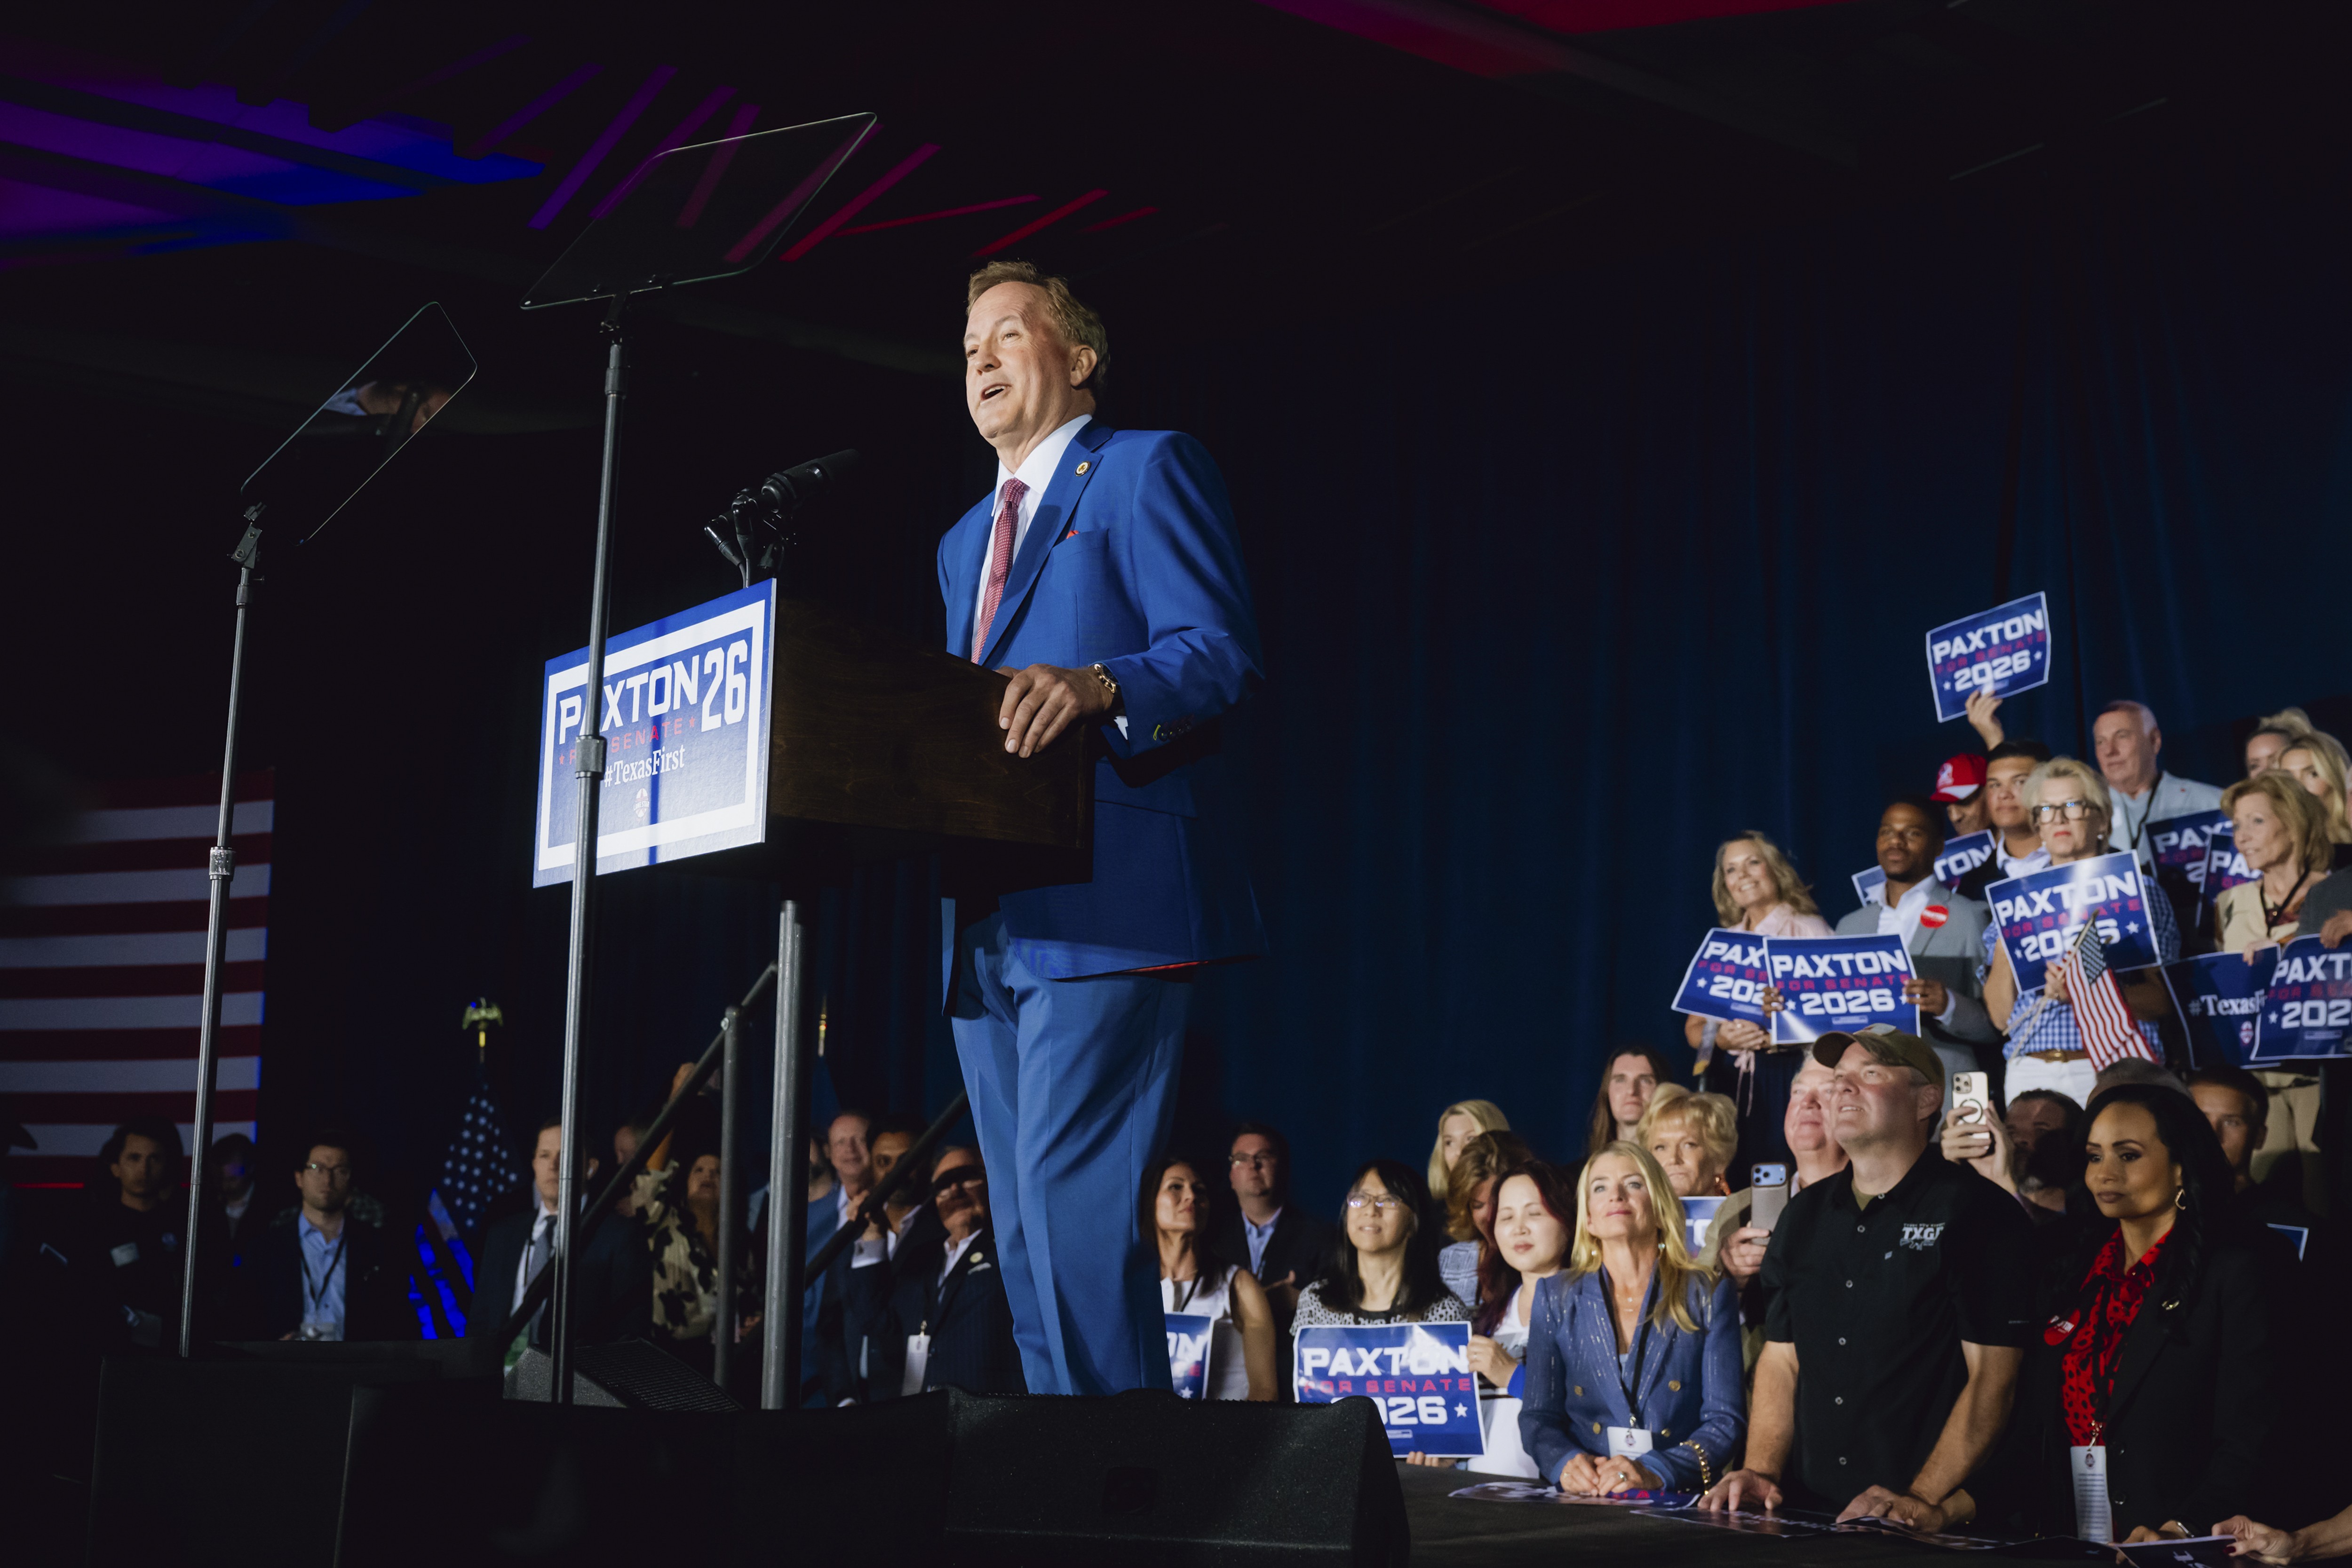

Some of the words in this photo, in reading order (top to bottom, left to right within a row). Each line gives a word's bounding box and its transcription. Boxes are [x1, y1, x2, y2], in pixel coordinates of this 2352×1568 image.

[1931, 608, 2045, 665] PAXTON
[1954, 649, 2031, 692] 2026
[559, 655, 699, 745] PXTON
[701, 639, 748, 732] 26
[611, 717, 683, 753] SENATE
[604, 745, 685, 788] #TexasFirst
[1994, 871, 2139, 927] PAXTON
[1703, 941, 1765, 968] PAX
[1771, 949, 1908, 979] PAXTON
[2270, 952, 2352, 987] PAXT
[1709, 975, 1768, 1005] 202
[1799, 988, 1895, 1015] 2026
[2281, 999, 2352, 1029] 202
[1301, 1345, 1470, 1377] PAXTON
[1366, 1378, 1471, 1393] SENATE
